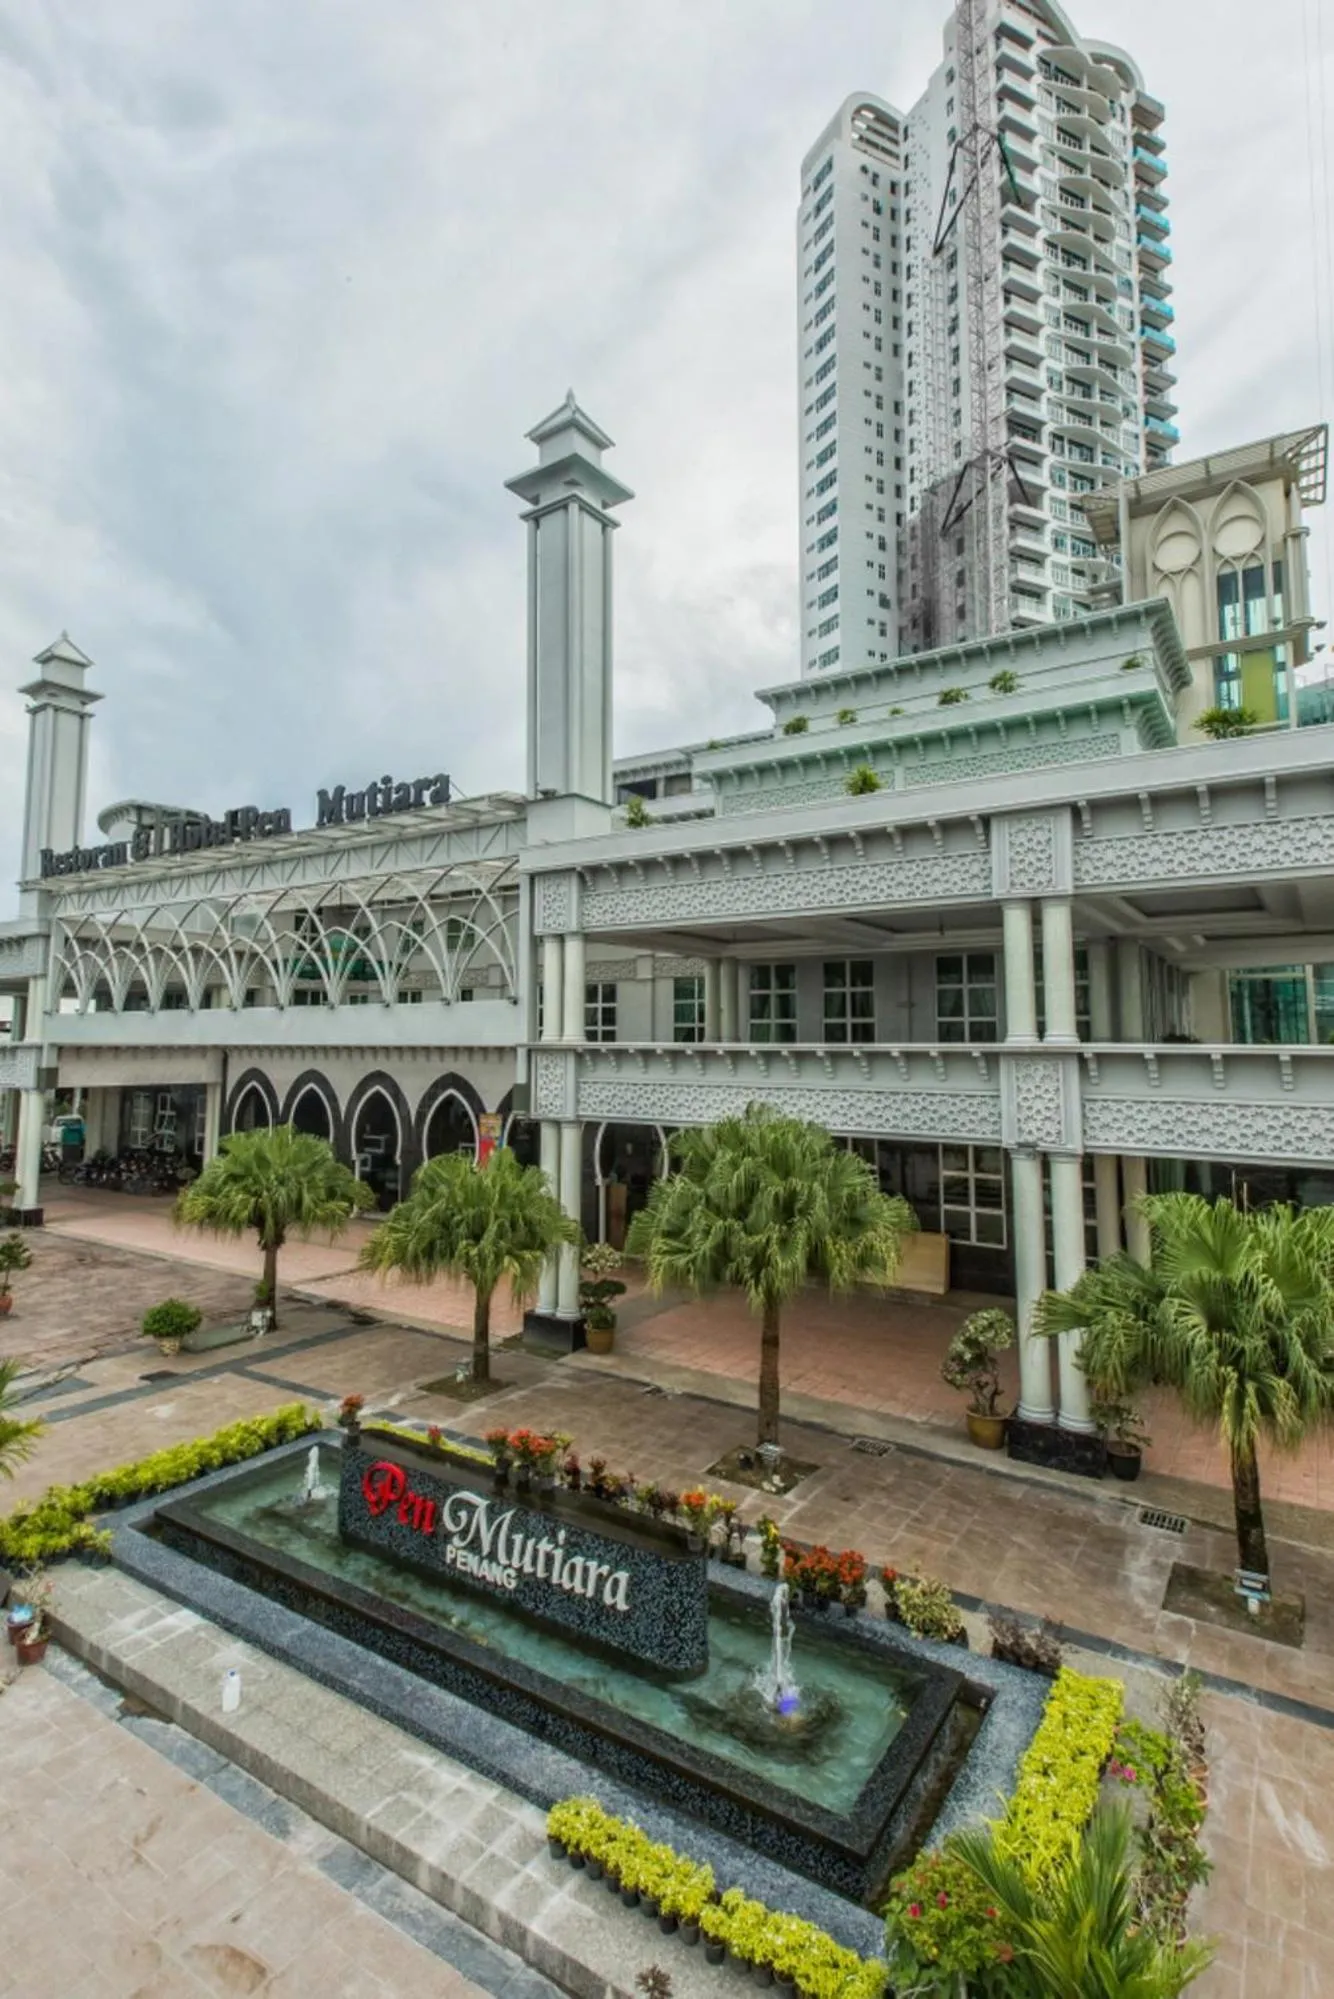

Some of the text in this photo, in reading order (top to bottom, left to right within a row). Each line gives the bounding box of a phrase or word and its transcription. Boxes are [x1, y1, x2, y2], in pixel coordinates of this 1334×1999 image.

[40, 841, 130, 878] Restoran
[237, 804, 292, 842] Pen
[316, 773, 451, 826] Mutiara
[361, 1460, 631, 1612] Pen Mutiara
[445, 1544, 519, 1590] PENANG
